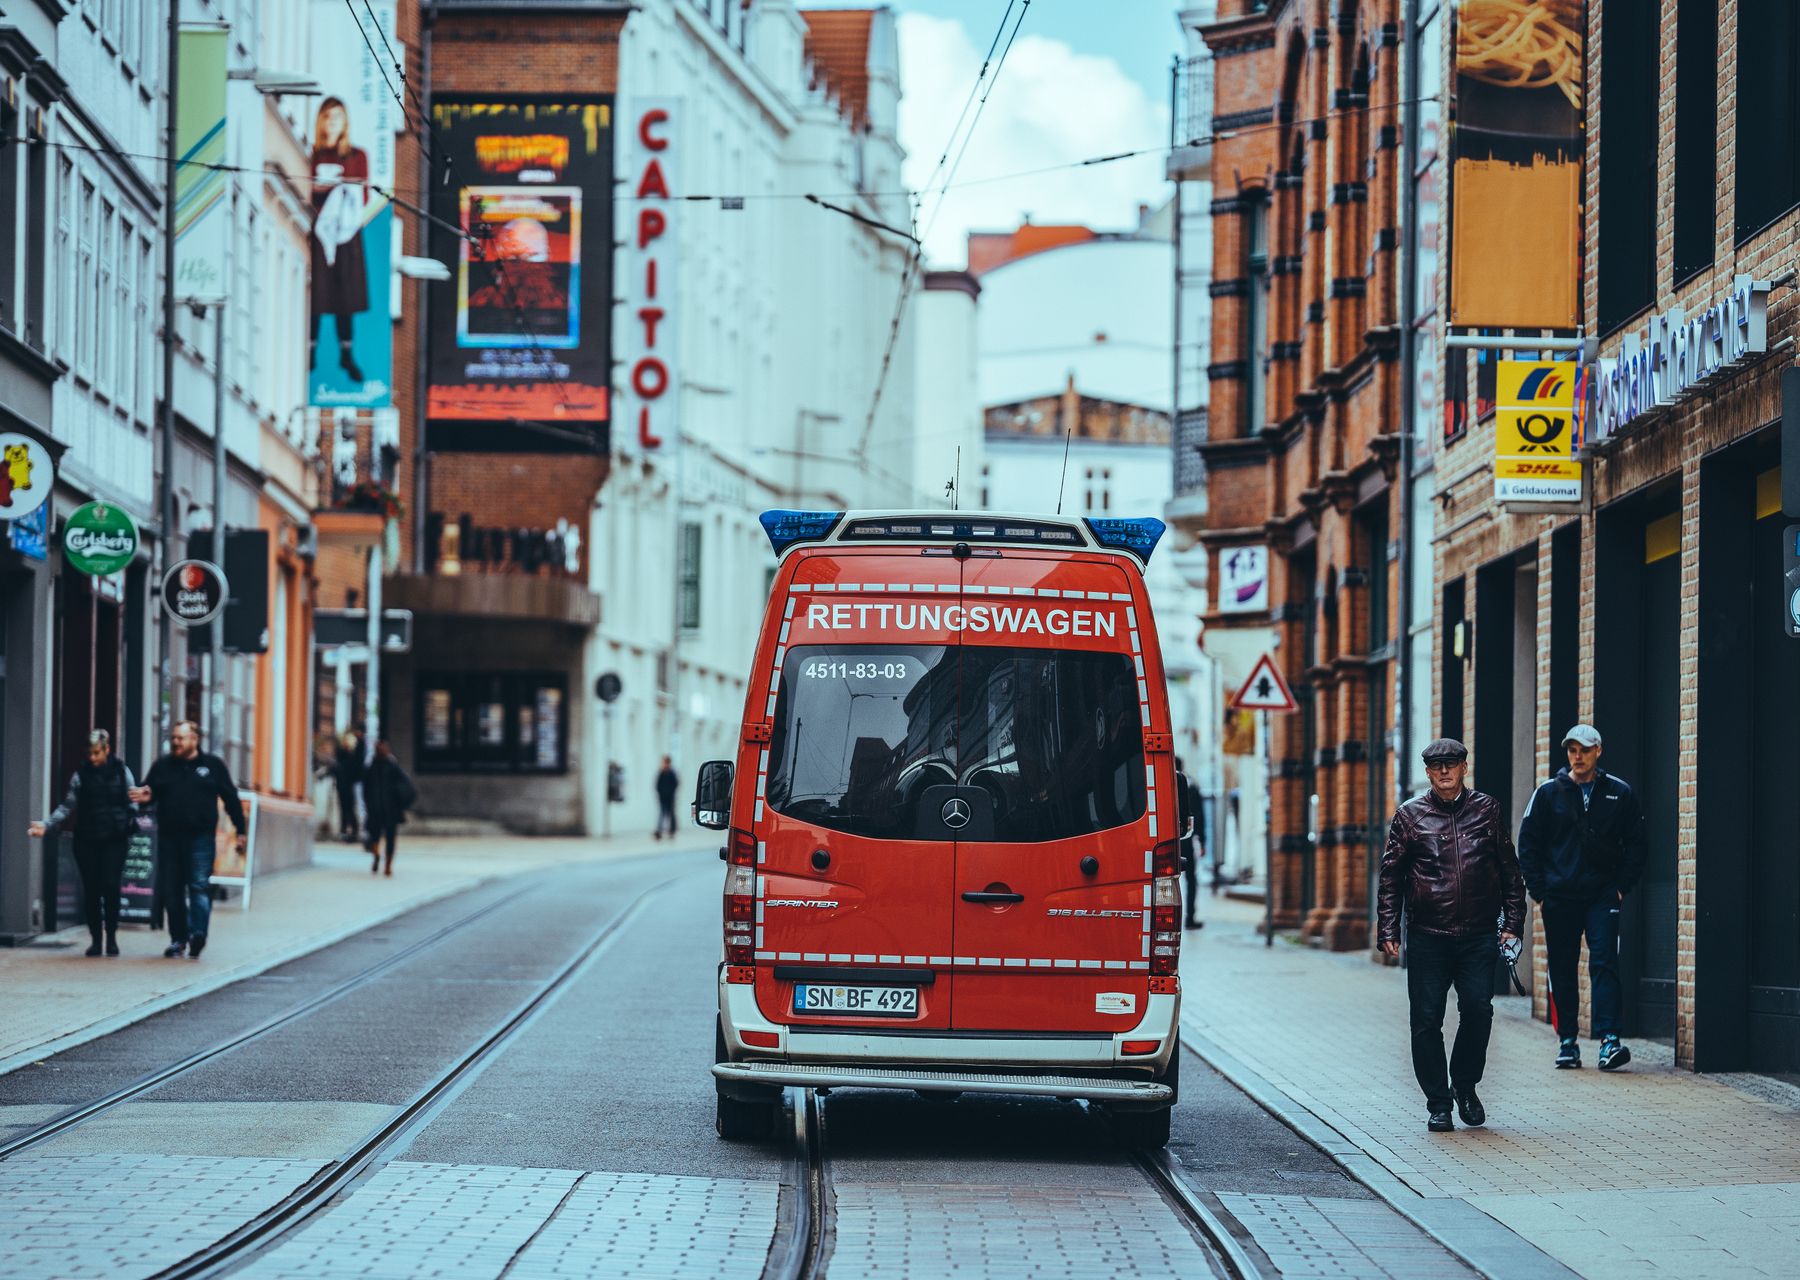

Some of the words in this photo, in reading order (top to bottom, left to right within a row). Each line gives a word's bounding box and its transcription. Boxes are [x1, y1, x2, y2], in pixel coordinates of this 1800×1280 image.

[632, 109, 669, 449] CAPITOL
[1515, 463, 1562, 475] DHL
[1512, 485, 1577, 496] Geldautomat
[65, 527, 133, 555] Carlsberg
[807, 604, 1115, 637] RETTUNGSWAGEN
[805, 662, 907, 680] 4511-83-03
[766, 899, 838, 908] SPRINTER
[1047, 908, 1073, 917] 316
[806, 987, 834, 1008] SN
[846, 988, 874, 1009] BF
[877, 990, 915, 1010] 492
